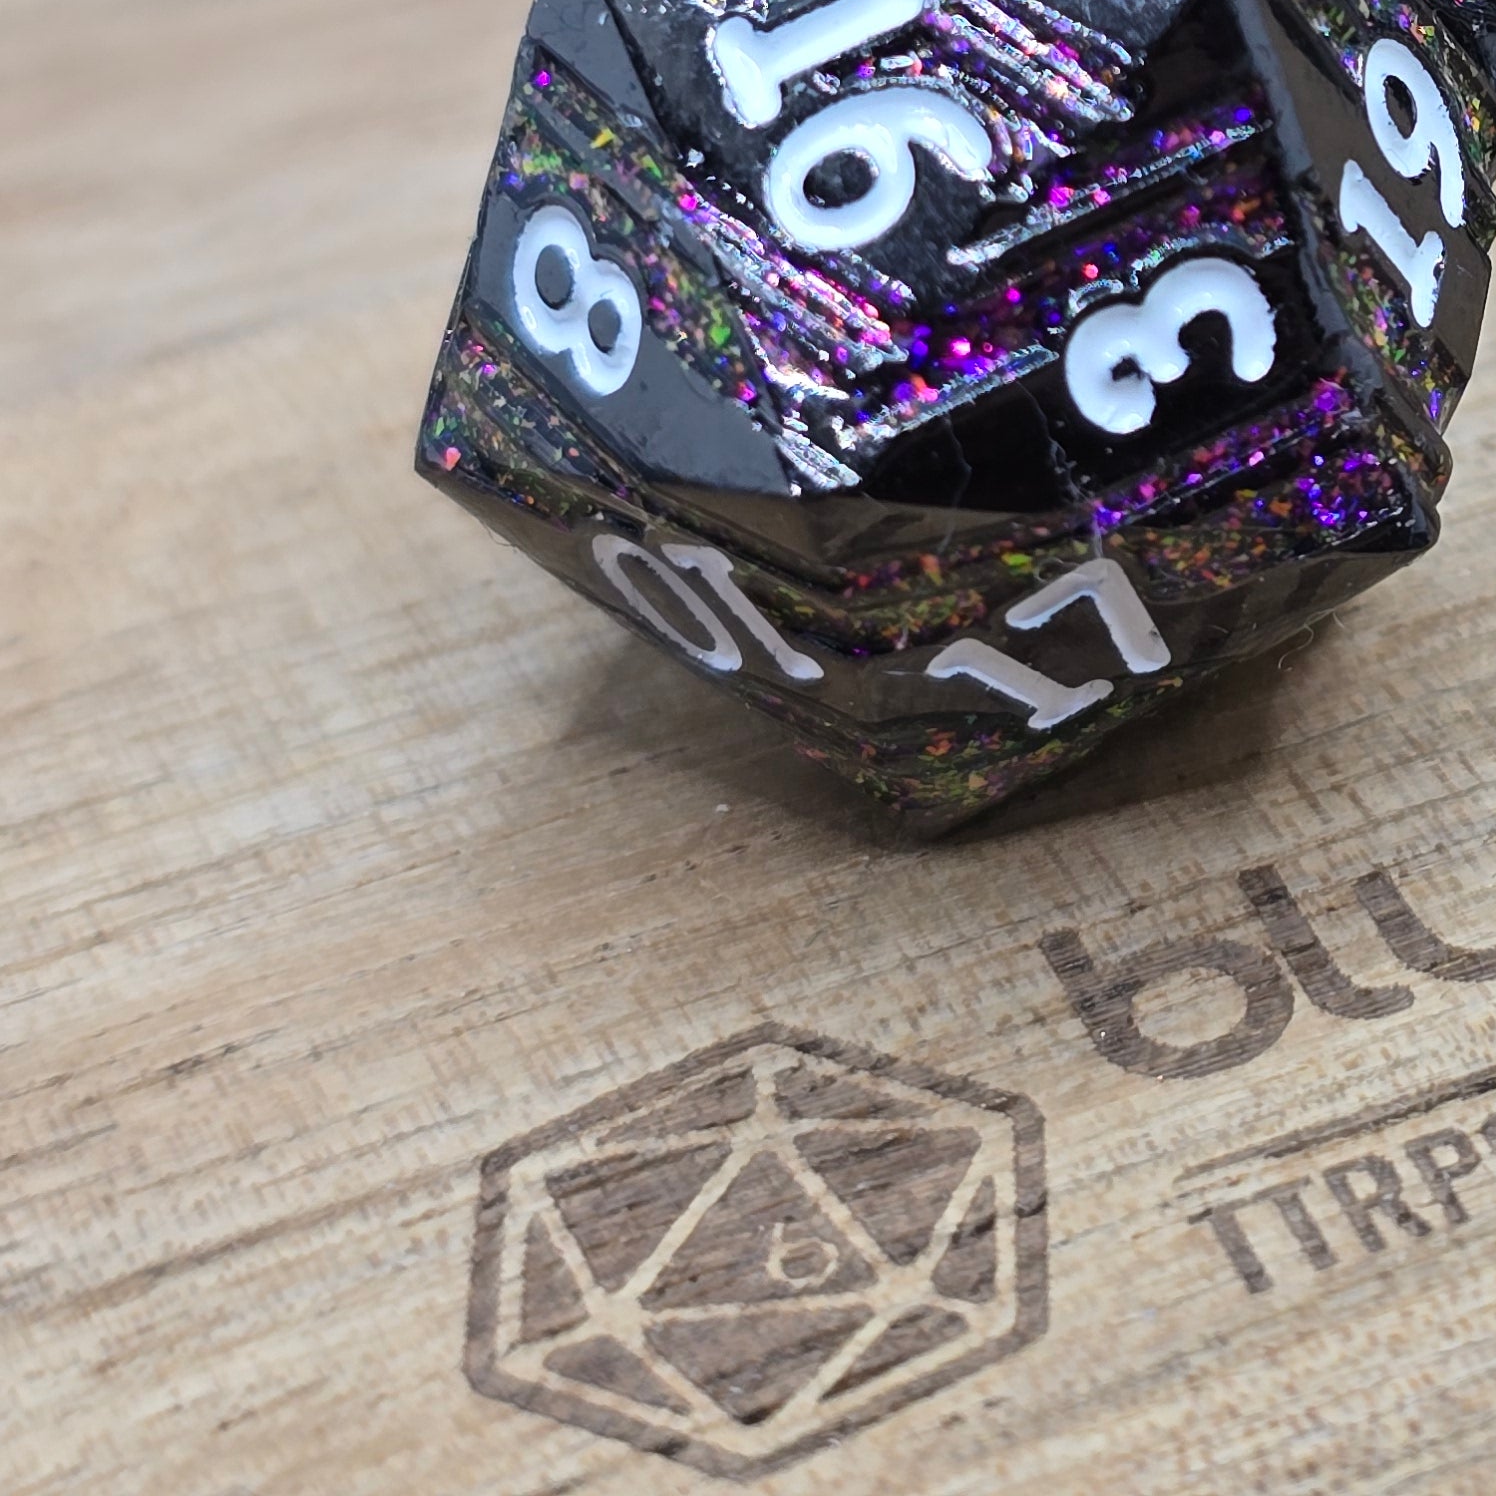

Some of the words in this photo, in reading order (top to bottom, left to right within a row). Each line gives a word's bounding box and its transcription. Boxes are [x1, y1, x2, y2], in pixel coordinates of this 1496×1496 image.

[1338, 37, 1467, 329] 19
[512, 204, 643, 398] 8
[1064, 256, 1278, 435] 3
[590, 531, 826, 682] 10
[925, 554, 1173, 731] 17
